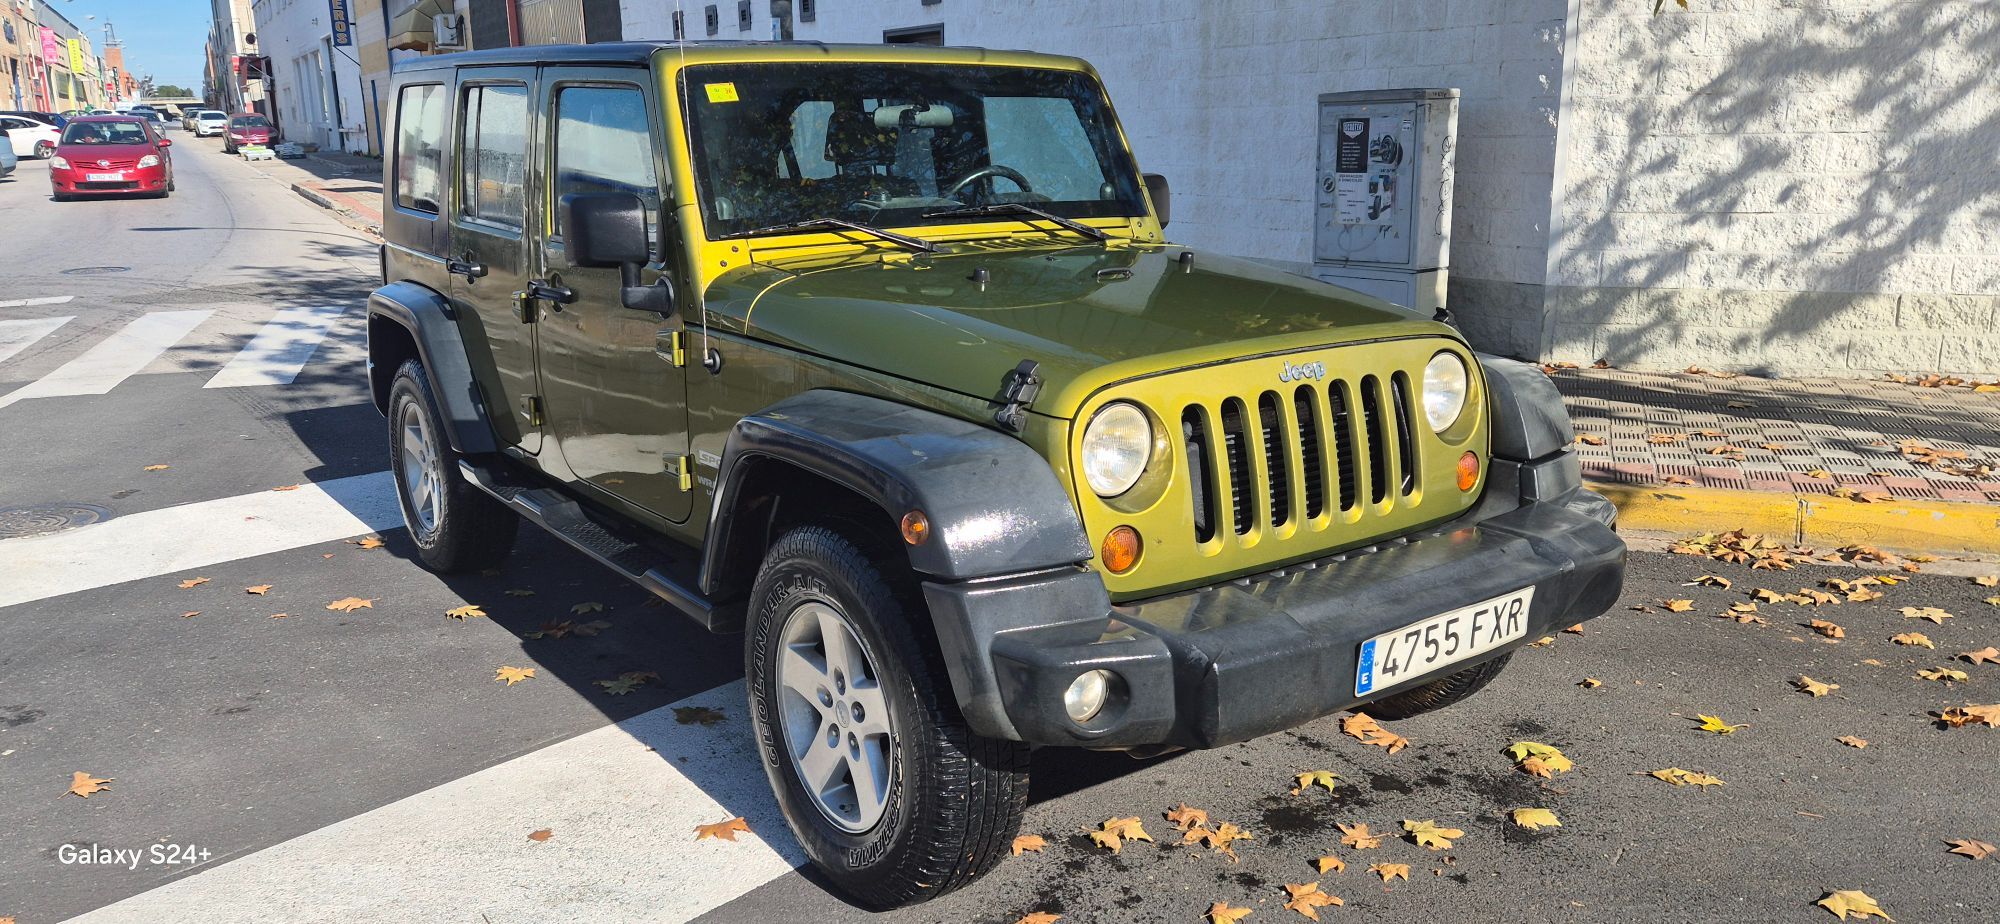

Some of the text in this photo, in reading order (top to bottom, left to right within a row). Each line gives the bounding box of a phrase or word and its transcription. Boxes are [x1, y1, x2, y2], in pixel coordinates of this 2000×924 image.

[1279, 360, 1326, 382] Jeep
[1382, 598, 1523, 677] 4755 FXR
[754, 581, 789, 768] GEOLANDAR
[1361, 672, 1369, 685] E
